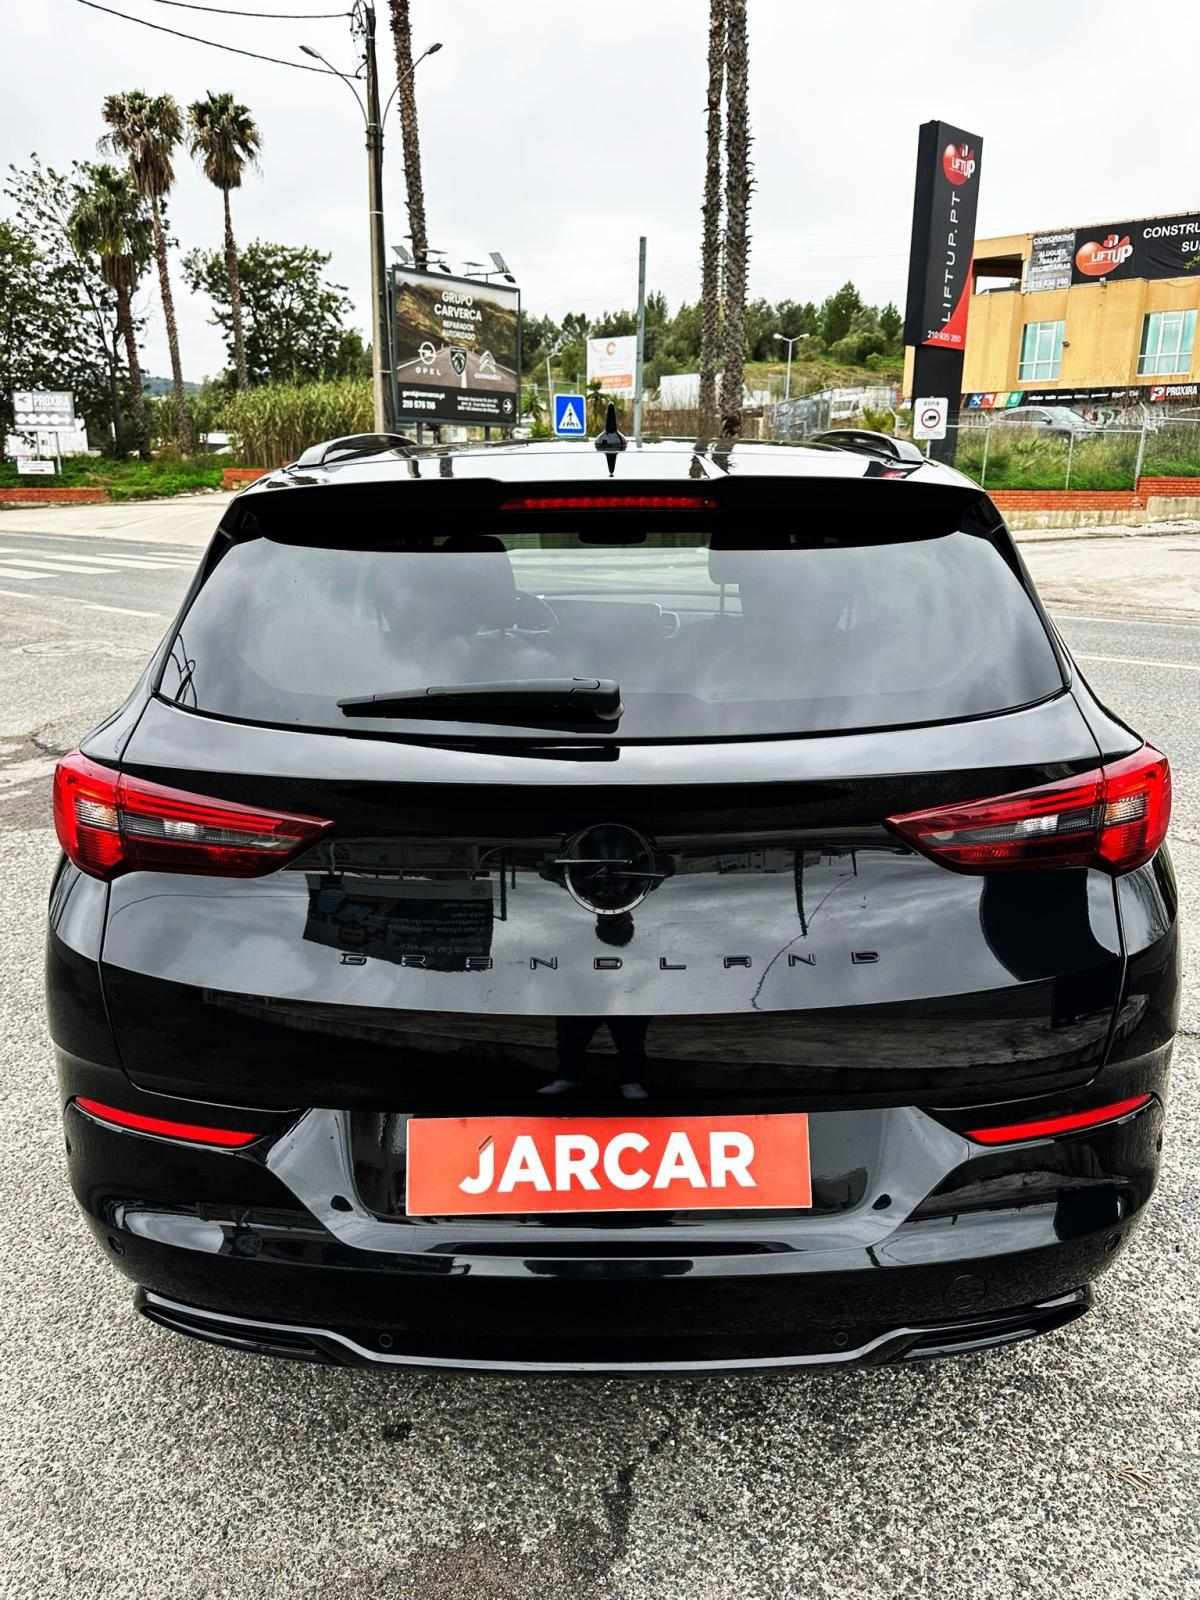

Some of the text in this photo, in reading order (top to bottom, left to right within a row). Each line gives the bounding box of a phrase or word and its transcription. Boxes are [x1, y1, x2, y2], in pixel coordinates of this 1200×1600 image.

[951, 157, 976, 179] LIFTUP
[941, 191, 961, 323] LIFTUP.PT
[1091, 244, 1134, 264] LIFTUP
[441, 291, 473, 306] GRUPO
[434, 303, 482, 322] CARVERCA
[415, 367, 442, 376] OPEL
[459, 1131, 758, 1195] JARCAR
